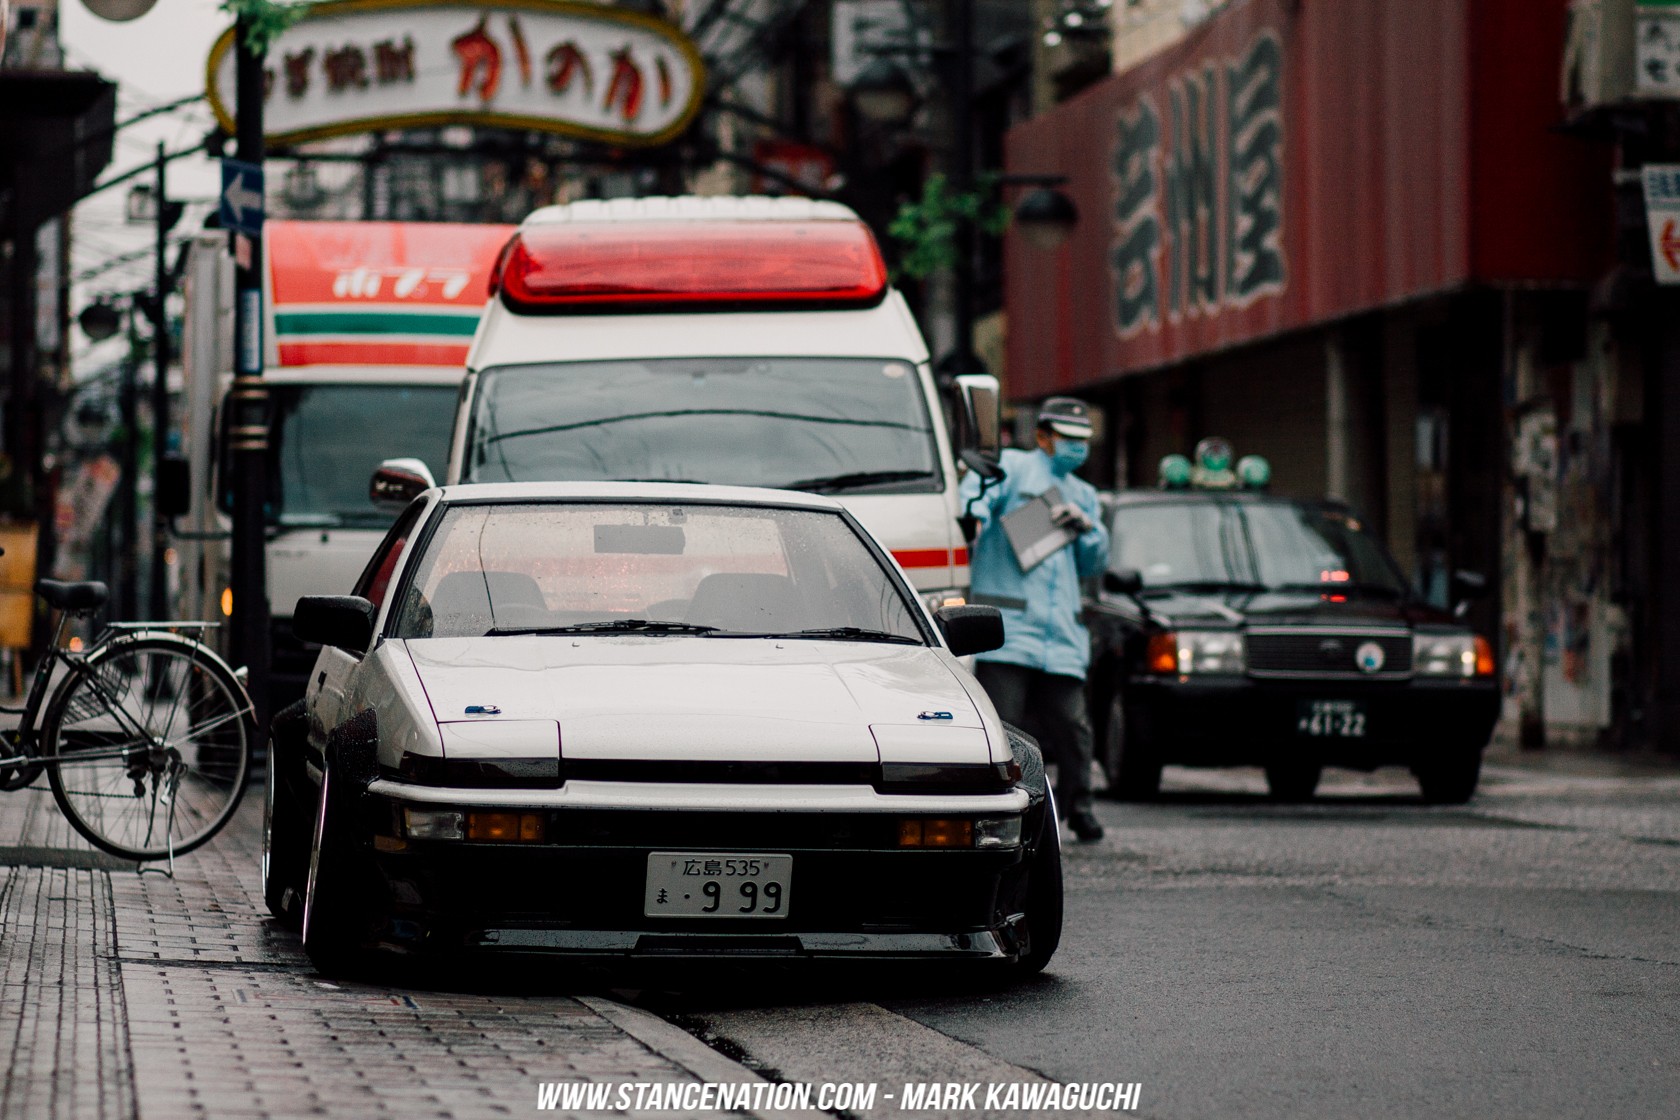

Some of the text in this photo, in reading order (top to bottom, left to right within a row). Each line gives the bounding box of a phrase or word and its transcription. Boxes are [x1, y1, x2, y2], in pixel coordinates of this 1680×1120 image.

[682, 859, 761, 876] 広島 535
[656, 888, 668, 904] ま
